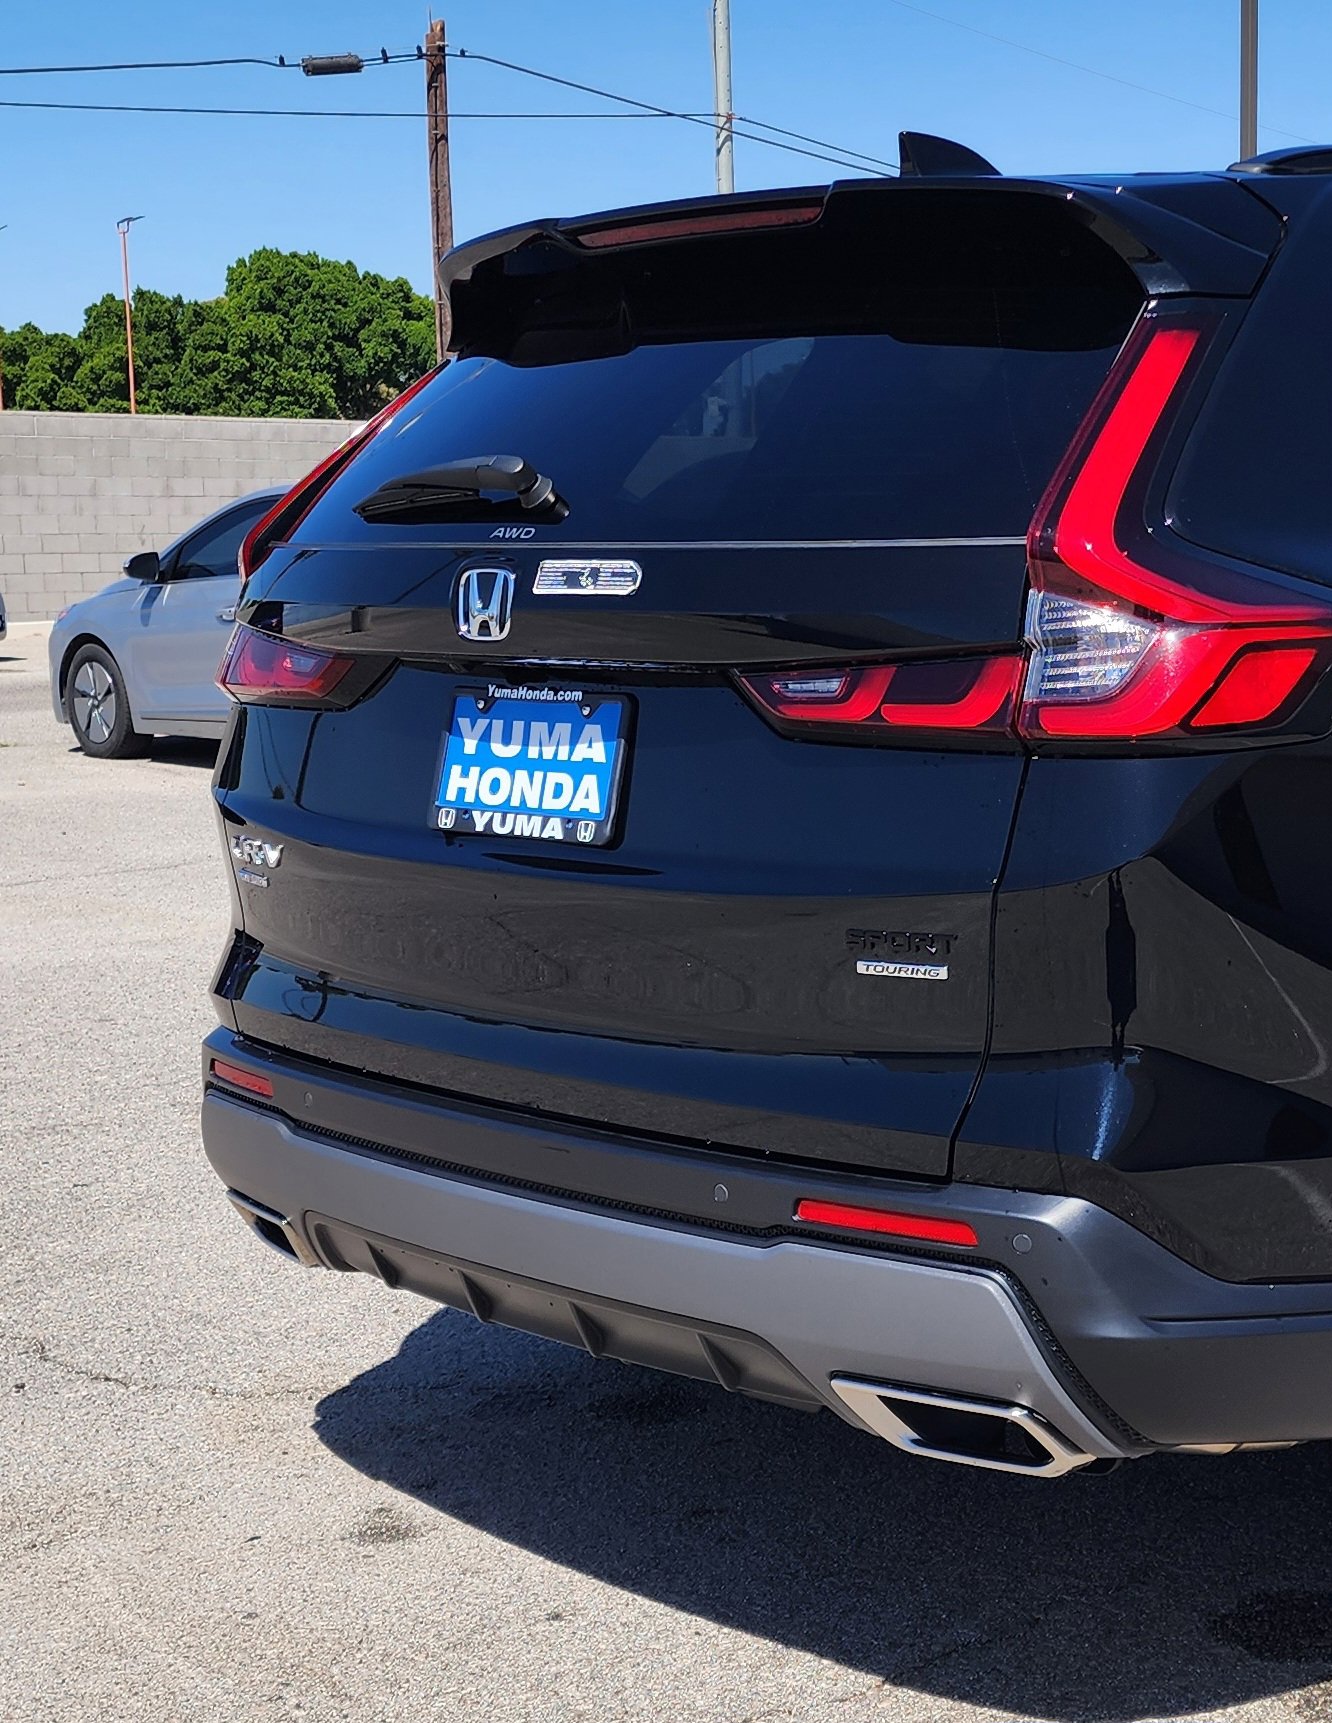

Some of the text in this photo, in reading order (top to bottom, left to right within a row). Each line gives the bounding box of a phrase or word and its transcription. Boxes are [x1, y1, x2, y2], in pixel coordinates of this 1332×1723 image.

[489, 526, 536, 539] AWD
[487, 684, 583, 701] YumaHonda.com
[457, 717, 607, 764] YUMA
[445, 764, 600, 814] HONDA
[472, 811, 564, 840] YUMA
[846, 928, 958, 956] SPORT
[862, 963, 941, 978] TOURING
